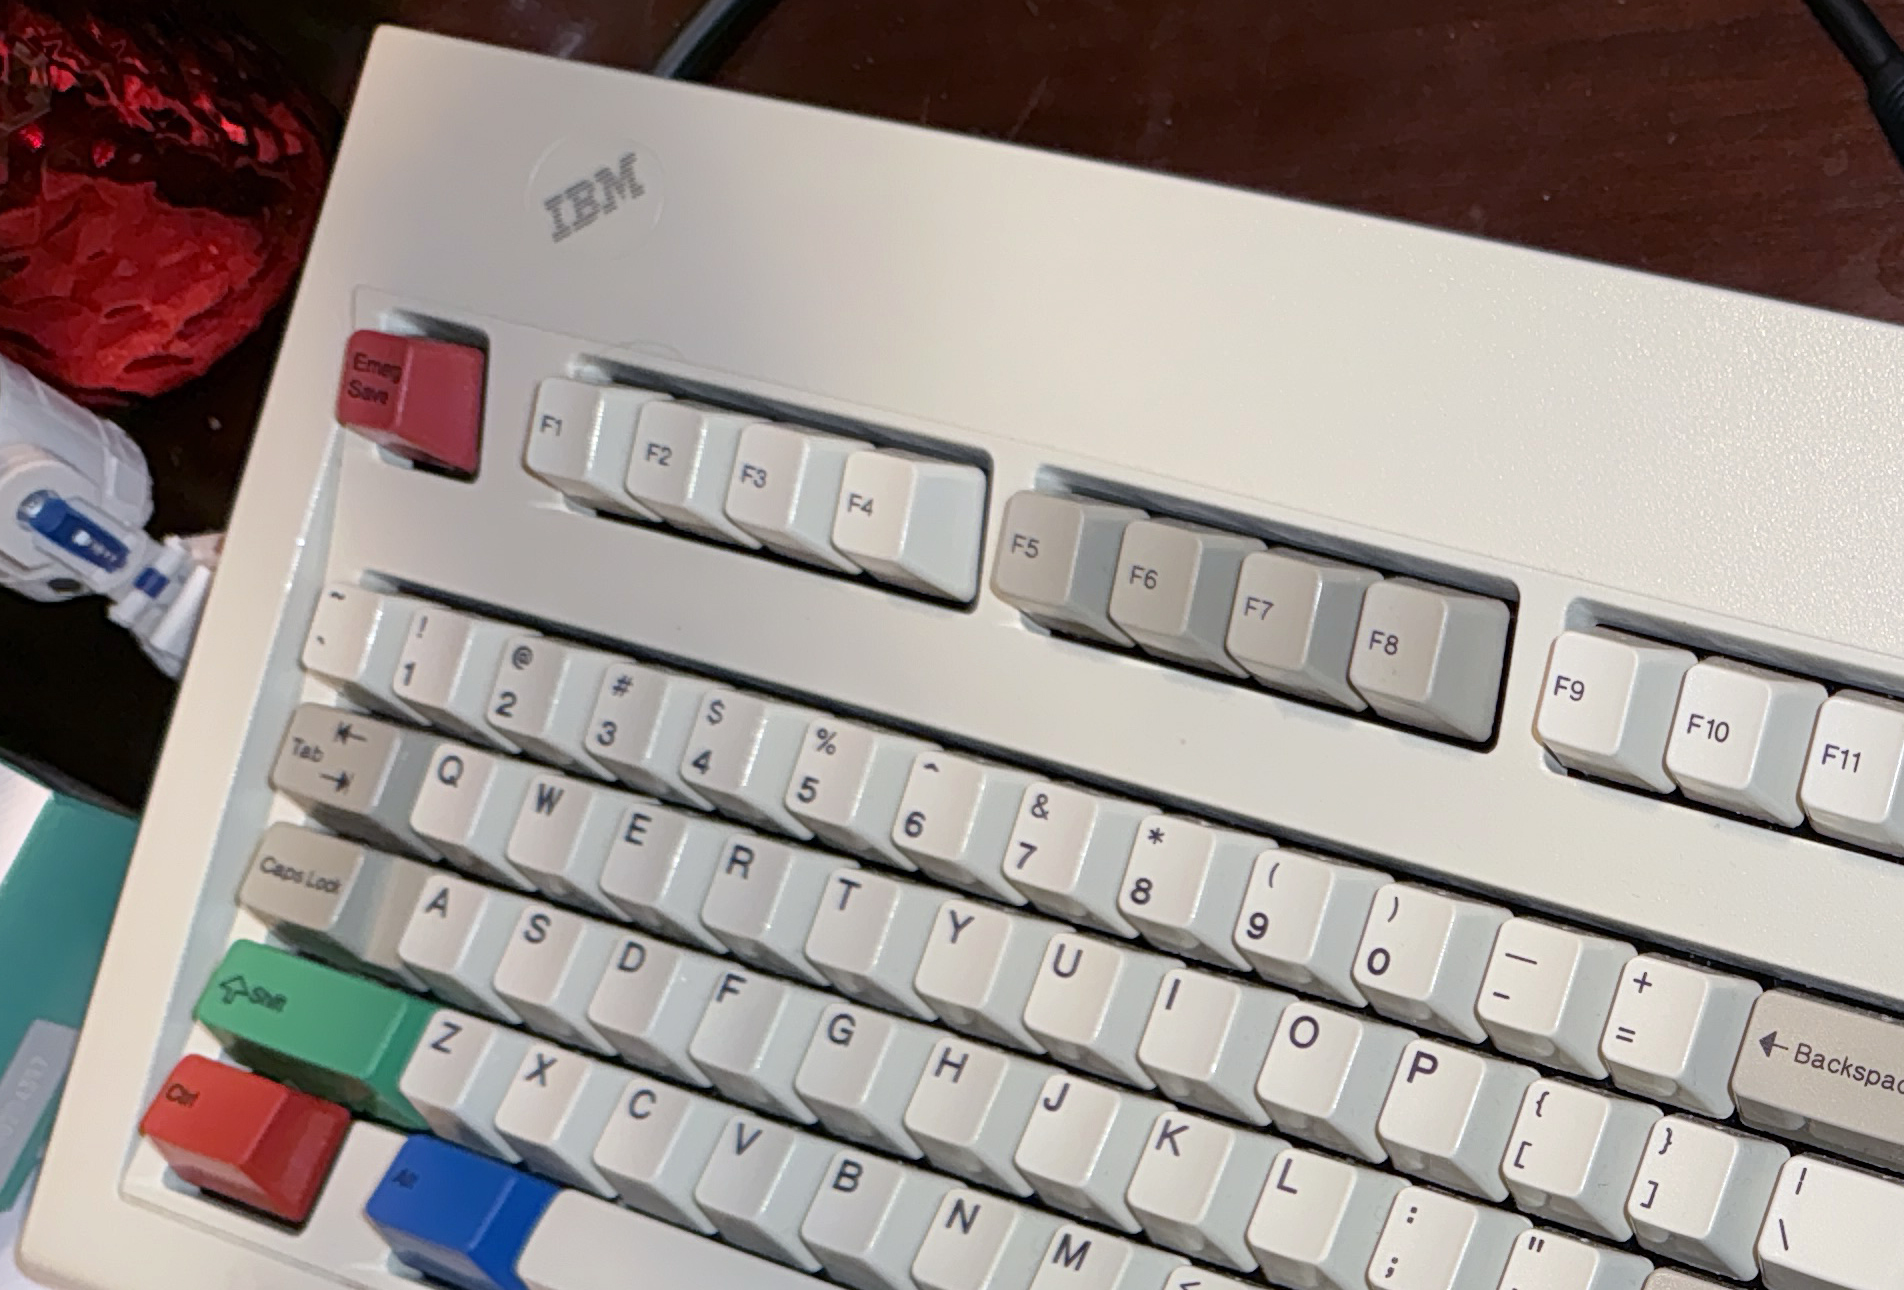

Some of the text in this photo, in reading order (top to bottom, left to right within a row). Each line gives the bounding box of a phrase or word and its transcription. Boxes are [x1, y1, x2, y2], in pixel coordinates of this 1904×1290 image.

[543, 152, 645, 243] IBM
[540, 414, 563, 436] F1
[646, 442, 672, 467] F2
[741, 464, 767, 489] F3
[847, 493, 874, 516] F4
[1011, 533, 1040, 559] F5
[1129, 565, 1158, 590] F6
[1244, 596, 1275, 621] F7
[511, 645, 533, 670] @
[1369, 629, 1399, 656] F8
[404, 662, 416, 686] 1
[612, 675, 632, 695] #
[1553, 675, 1585, 702] F9
[495, 691, 517, 718] 2
[706, 699, 725, 725] $
[597, 720, 617, 747] 3
[816, 727, 837, 756] %
[1686, 713, 1730, 743] F10
[293, 737, 323, 763] Tab
[691, 750, 711, 774] 4
[1821, 743, 1861, 773] F11
[437, 755, 464, 787] Q
[536, 783, 564, 815] W
[797, 776, 819, 804] 5
[1030, 793, 1049, 820] &
[624, 812, 652, 846] E
[904, 811, 925, 838] 6
[726, 844, 754, 879] R
[1017, 841, 1038, 869] 7
[260, 856, 342, 896] Caps Lock
[1130, 877, 1153, 905] 8
[425, 887, 449, 917] A
[839, 877, 861, 910] T
[524, 913, 551, 944] S
[949, 909, 975, 944] Y
[1246, 912, 1269, 940] 9
[617, 941, 646, 973] D
[1052, 943, 1083, 979] U
[716, 973, 746, 1002] F
[1633, 971, 1653, 994] +
[430, 1021, 462, 1054] Z
[827, 1013, 856, 1046] G
[1289, 1015, 1320, 1049] O
[525, 1053, 557, 1086] X
[934, 1047, 969, 1083] H
[1406, 1050, 1439, 1083] P
[628, 1089, 656, 1120] C
[1043, 1082, 1070, 1112] J
[1535, 1090, 1550, 1118] {
[735, 1122, 763, 1156] V
[1155, 1119, 1189, 1157] K
[1658, 1127, 1673, 1155] }
[1513, 1140, 1533, 1170] [
[832, 1159, 863, 1193] B
[1276, 1157, 1298, 1195] L
[1640, 1180, 1659, 1209] ]
[945, 1198, 981, 1235] N
[1778, 1218, 1789, 1251] \
[1052, 1233, 1092, 1271] M
